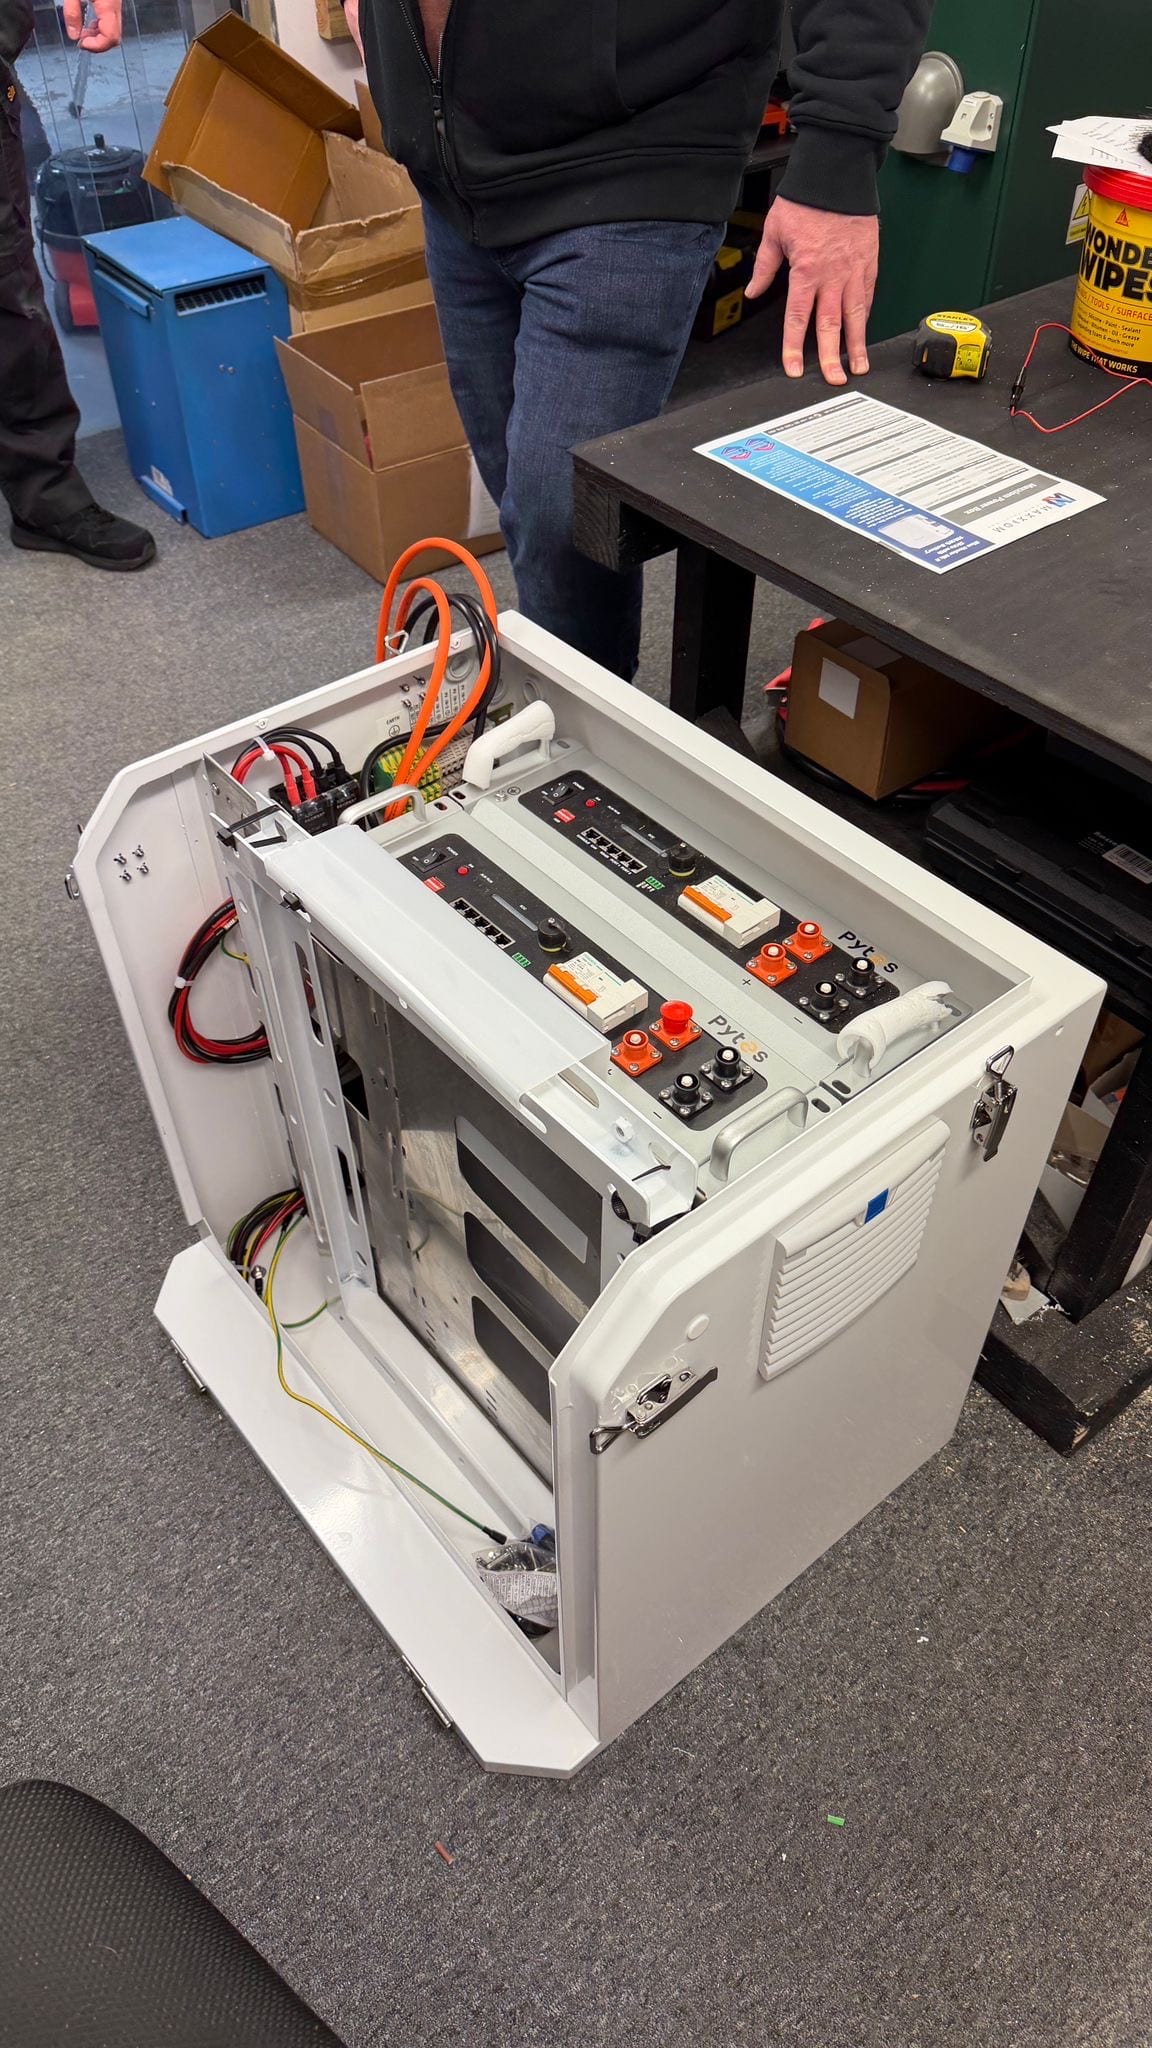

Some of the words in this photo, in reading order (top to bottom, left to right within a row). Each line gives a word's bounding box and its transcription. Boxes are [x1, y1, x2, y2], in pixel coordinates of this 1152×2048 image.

[1085, 221, 1152, 270] WONDE
[1091, 296, 1110, 312] TOOLS
[1116, 306, 1152, 321] SURFACE
[1105, 320, 1118, 329] Paint
[1121, 325, 1141, 334] Sealant
[1107, 337, 1120, 345] much
[1122, 333, 1140, 341] Grease
[1077, 345, 1090, 360] WIPE
[1108, 360, 1138, 373] WORKS
[386, 715, 400, 725] EARTH
